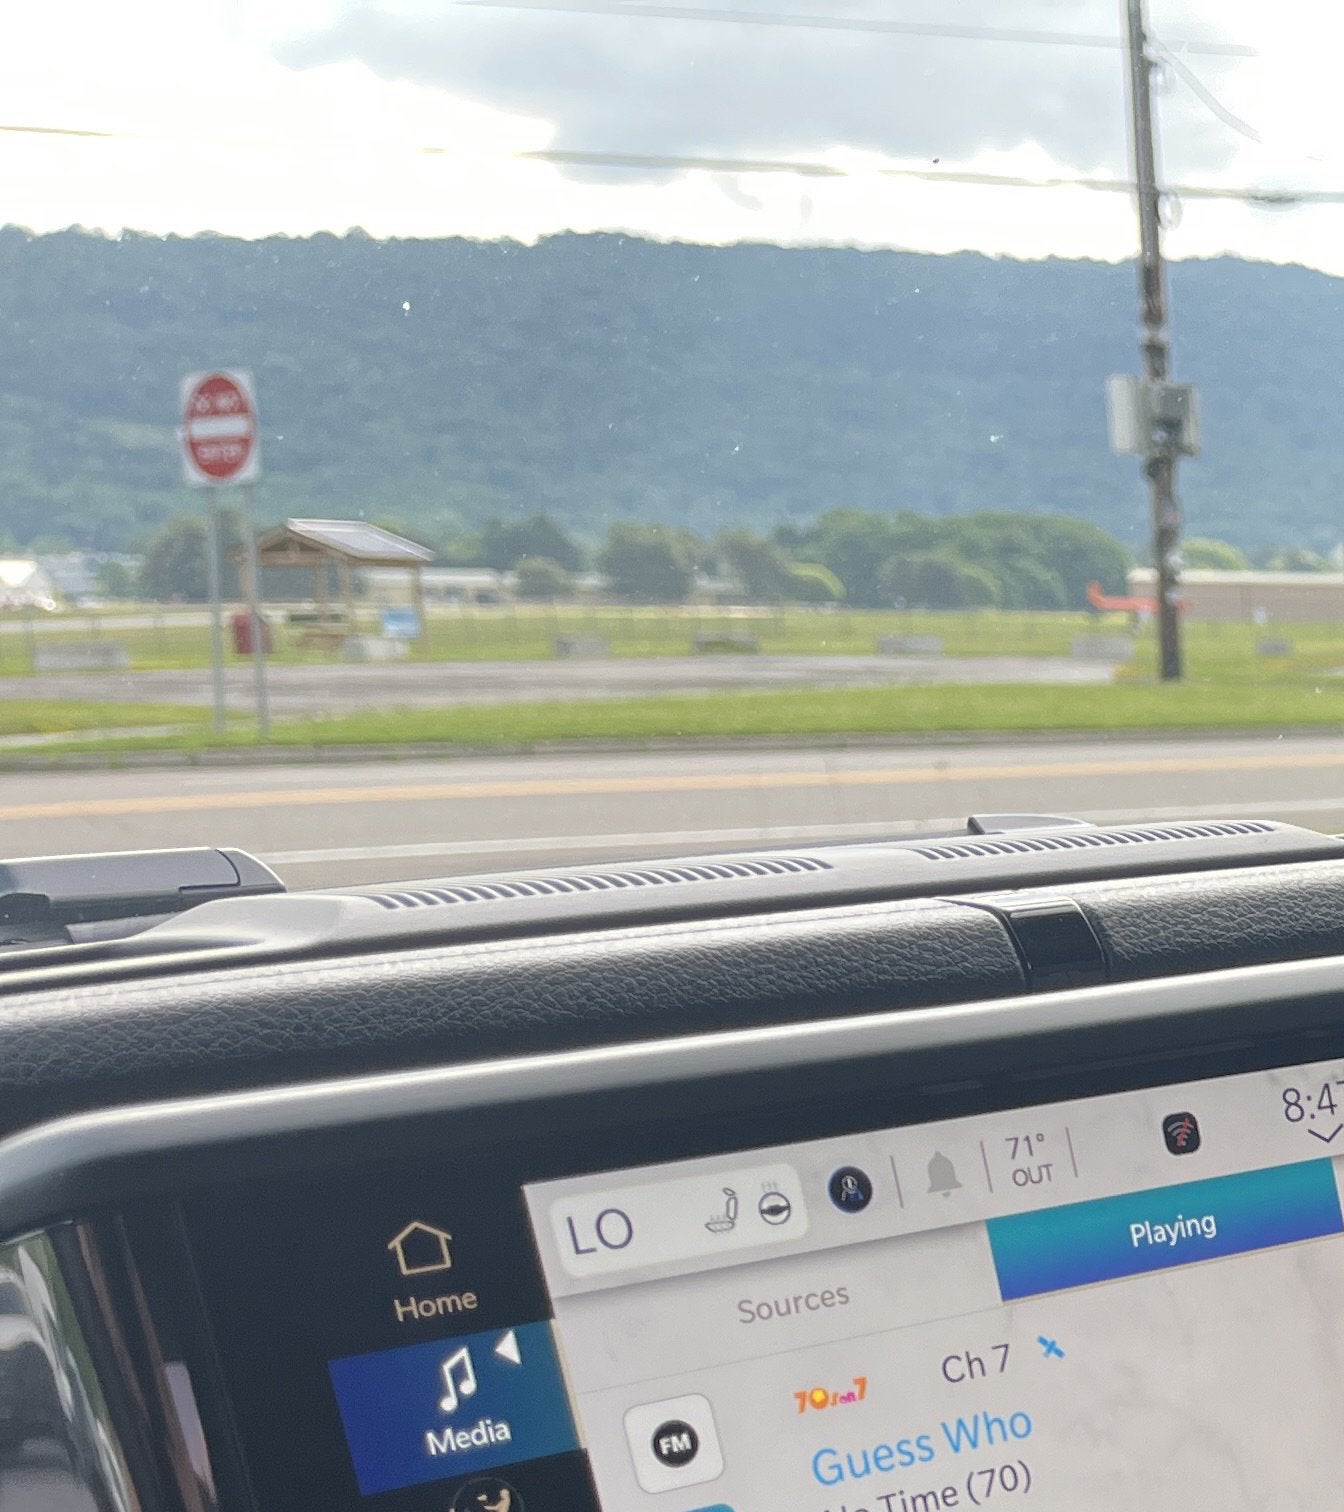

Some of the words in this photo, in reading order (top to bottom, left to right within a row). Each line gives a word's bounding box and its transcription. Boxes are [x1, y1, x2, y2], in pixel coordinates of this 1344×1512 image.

[1012, 1162, 1054, 1187] OUT
[566, 1208, 634, 1255] LO
[1129, 1212, 1217, 1248] Playing
[394, 1290, 478, 1323] Home
[737, 1284, 850, 1324] Sources
[941, 1350, 987, 1383] Ch
[991, 1343, 1010, 1374] 7
[426, 1419, 511, 1456] Media
[658, 1433, 692, 1456] FM
[811, 1433, 935, 1485] Guess
[940, 1410, 1033, 1454] Who
[966, 1460, 1032, 1507] (70)
